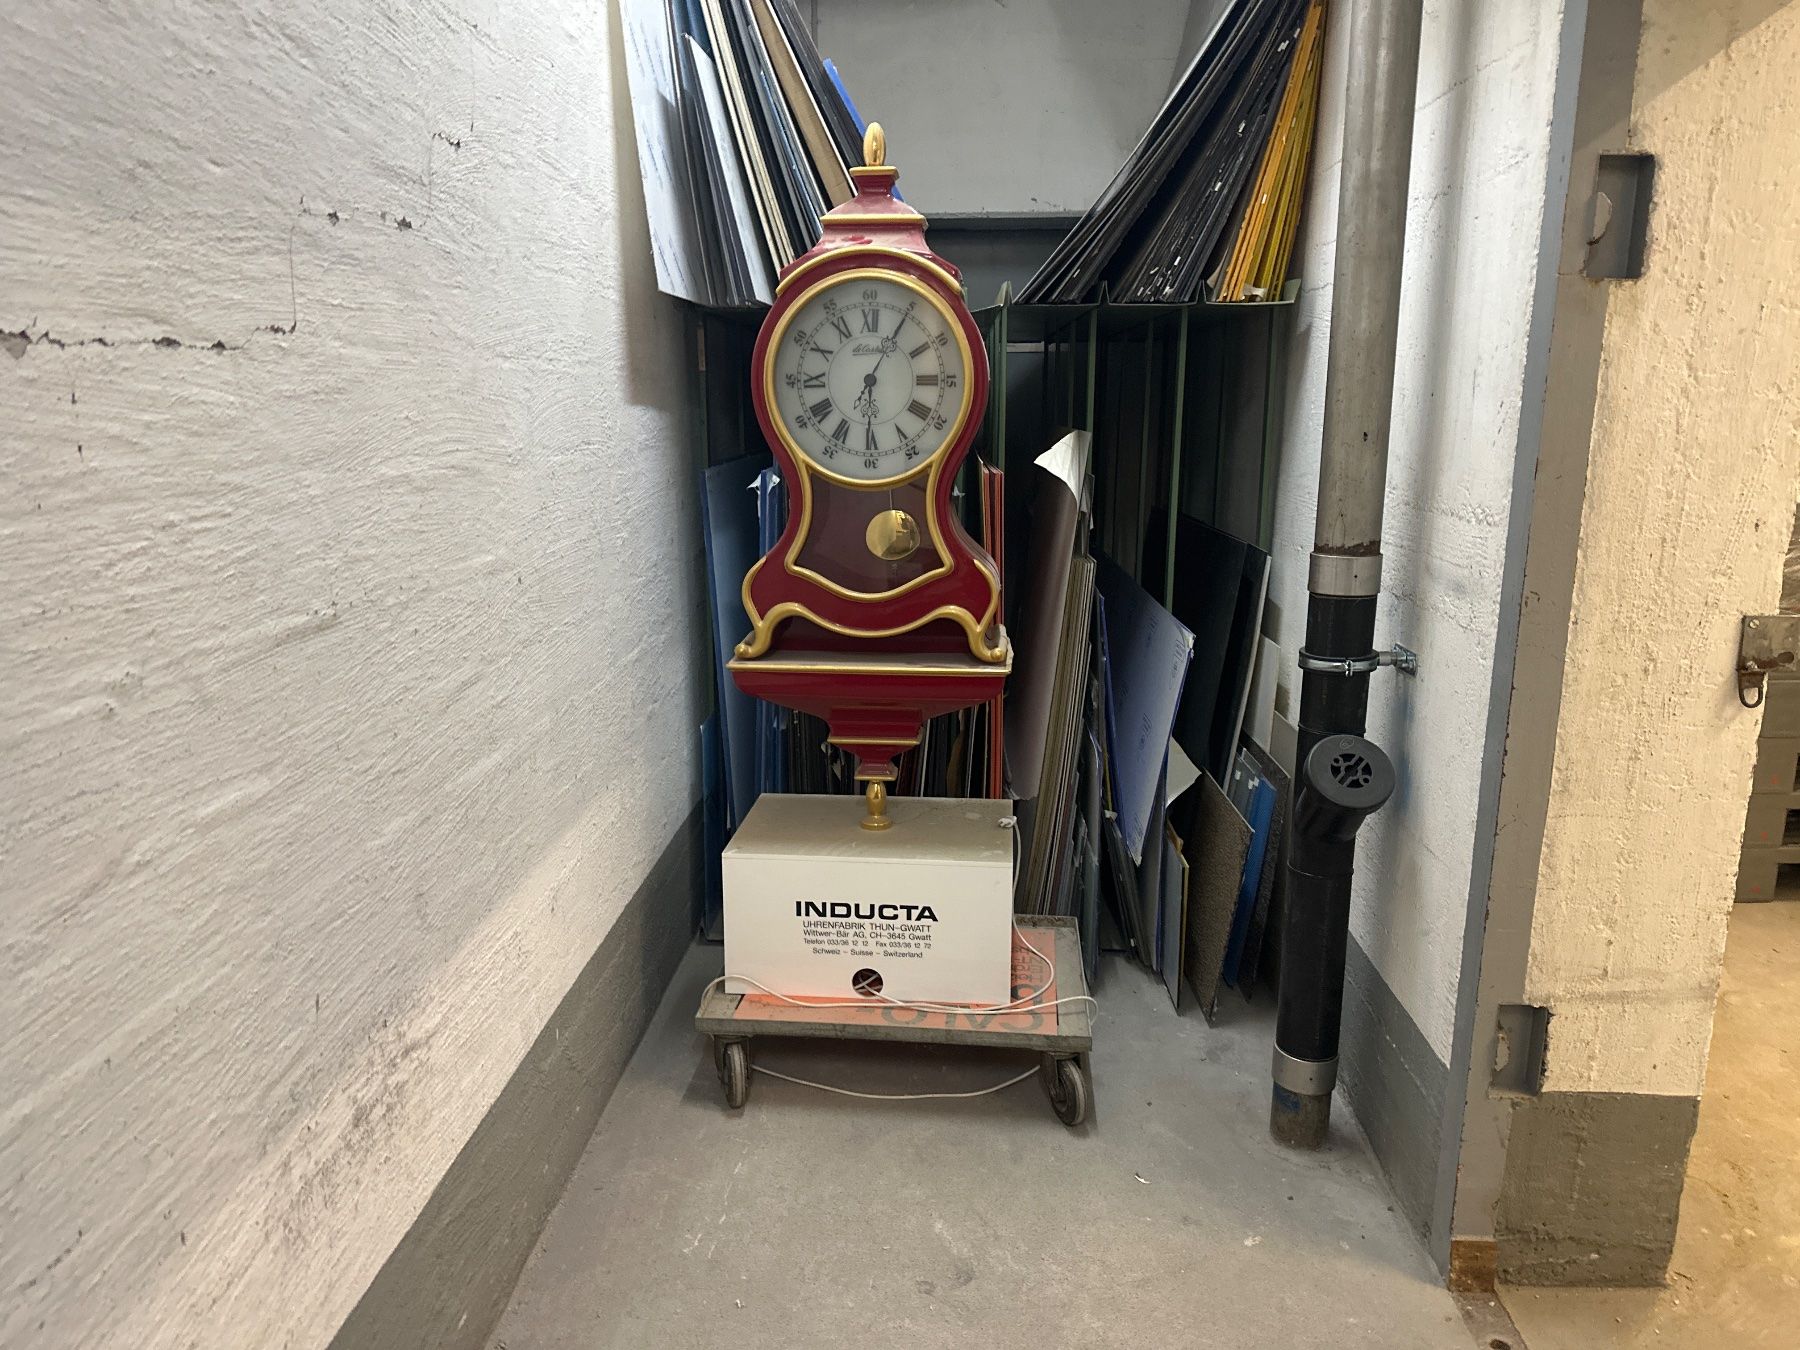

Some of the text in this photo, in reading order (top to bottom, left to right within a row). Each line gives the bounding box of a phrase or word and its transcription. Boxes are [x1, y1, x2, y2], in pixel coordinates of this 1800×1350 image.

[862, 289, 878, 300] 60
[823, 299, 837, 315] 55
[906, 301, 917, 312] 5
[861, 308, 880, 333] XII
[831, 315, 852, 344] XI
[794, 329, 807, 347] 50
[935, 332, 948, 346] 10
[806, 341, 834, 362] X
[909, 341, 931, 359] II
[786, 373, 796, 388] 45
[803, 372, 826, 388] IX
[916, 374, 938, 386] III
[946, 375, 957, 388] 15
[809, 397, 834, 424] VIII
[795, 415, 808, 429] 40
[933, 414, 947, 430] 20
[831, 418, 851, 444] VII
[894, 422, 909, 443] V
[822, 445, 838, 459] 35
[904, 445, 920, 460] 25
[864, 458, 879, 469] 30
[796, 901, 938, 922] INDUCTA
[803, 920, 931, 932] UHRENFABRIK THUN-GWATT
[803, 929, 849, 938] Wittwer-Bär
[870, 931, 905, 940] CH-3645
[908, 933, 931, 941] Gwatt
[812, 947, 841, 955] Schweiz
[850, 948, 874, 956] Suisse
[883, 950, 923, 958] Switzerland
